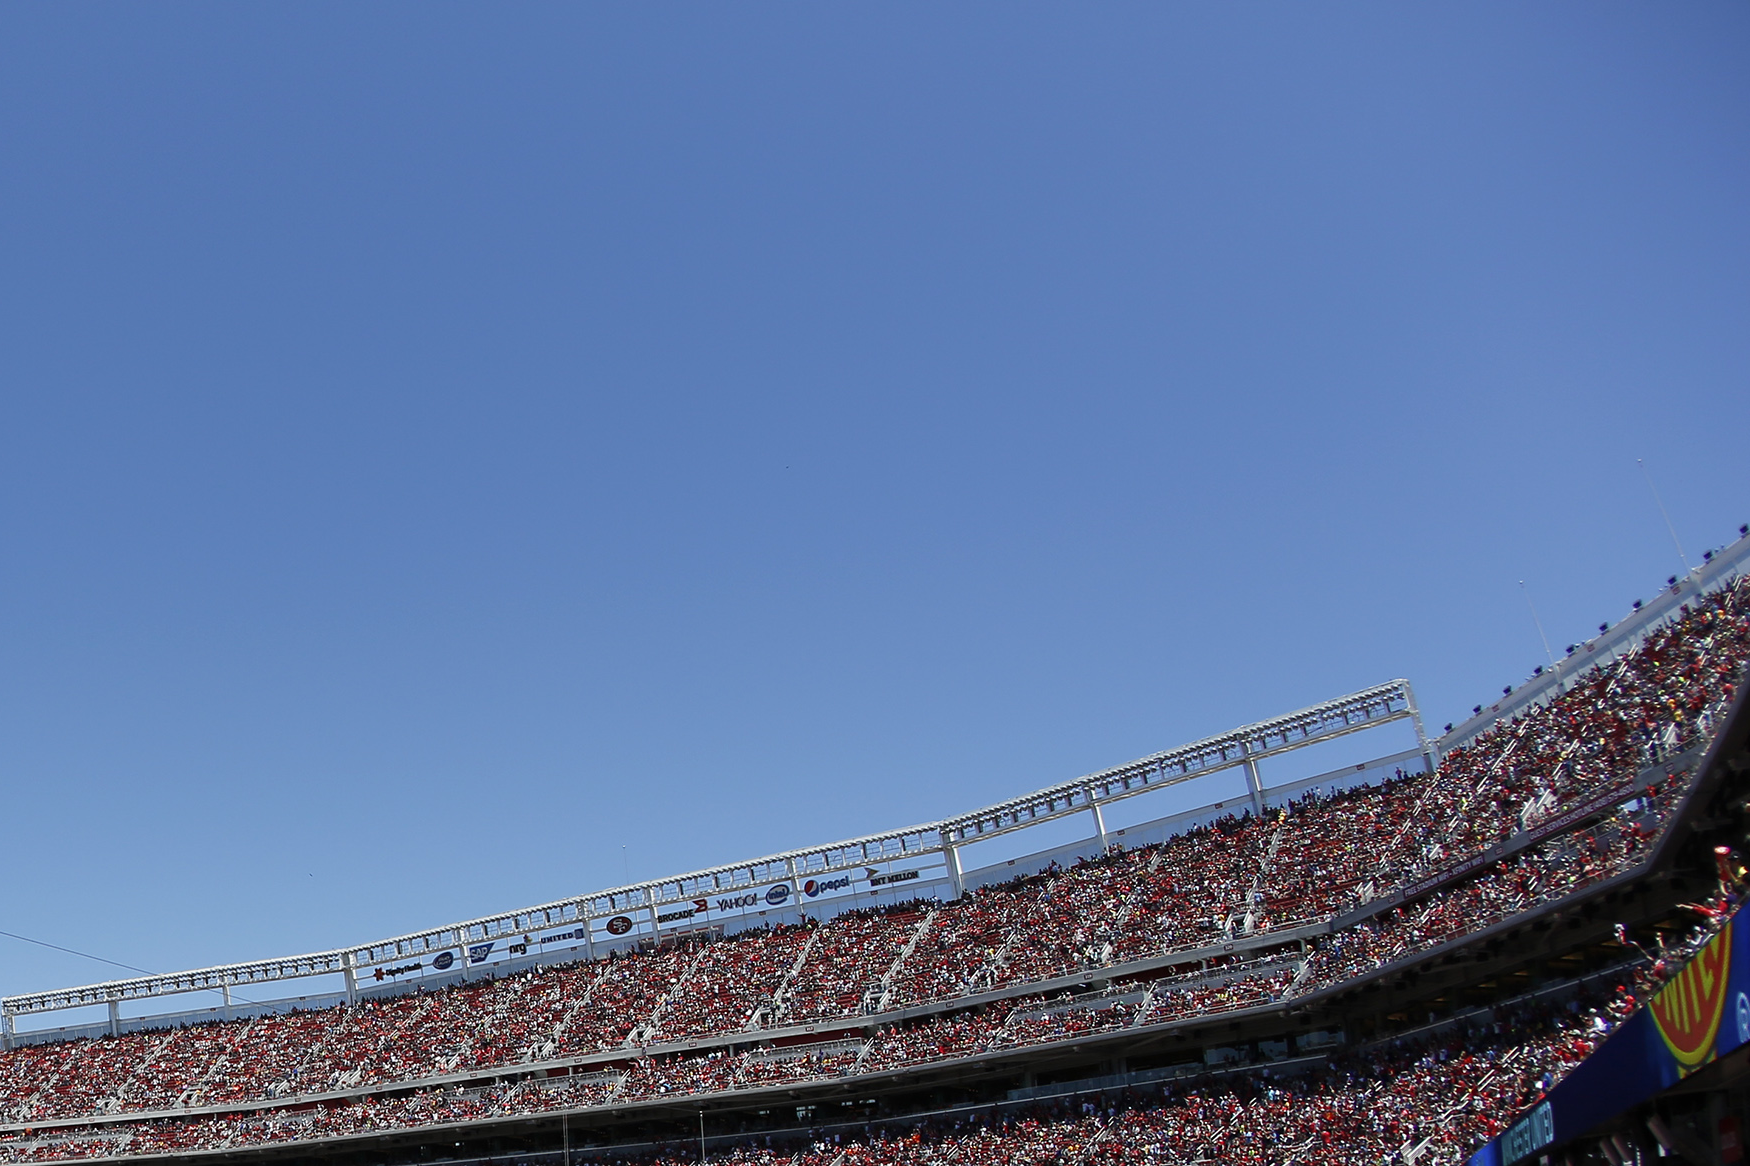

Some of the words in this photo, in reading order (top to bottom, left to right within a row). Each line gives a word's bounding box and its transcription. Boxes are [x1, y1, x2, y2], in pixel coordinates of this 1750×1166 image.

[888, 871, 918, 883] MELLON
[818, 876, 850, 893] pepsi
[768, 888, 785, 899] intel
[717, 893, 758, 912] YAHOO!
[658, 910, 694, 924] BROCADE
[613, 918, 628, 932] SF
[540, 932, 574, 944] UNITED
[470, 946, 488, 962] SAP
[510, 943, 526, 955] nrg
